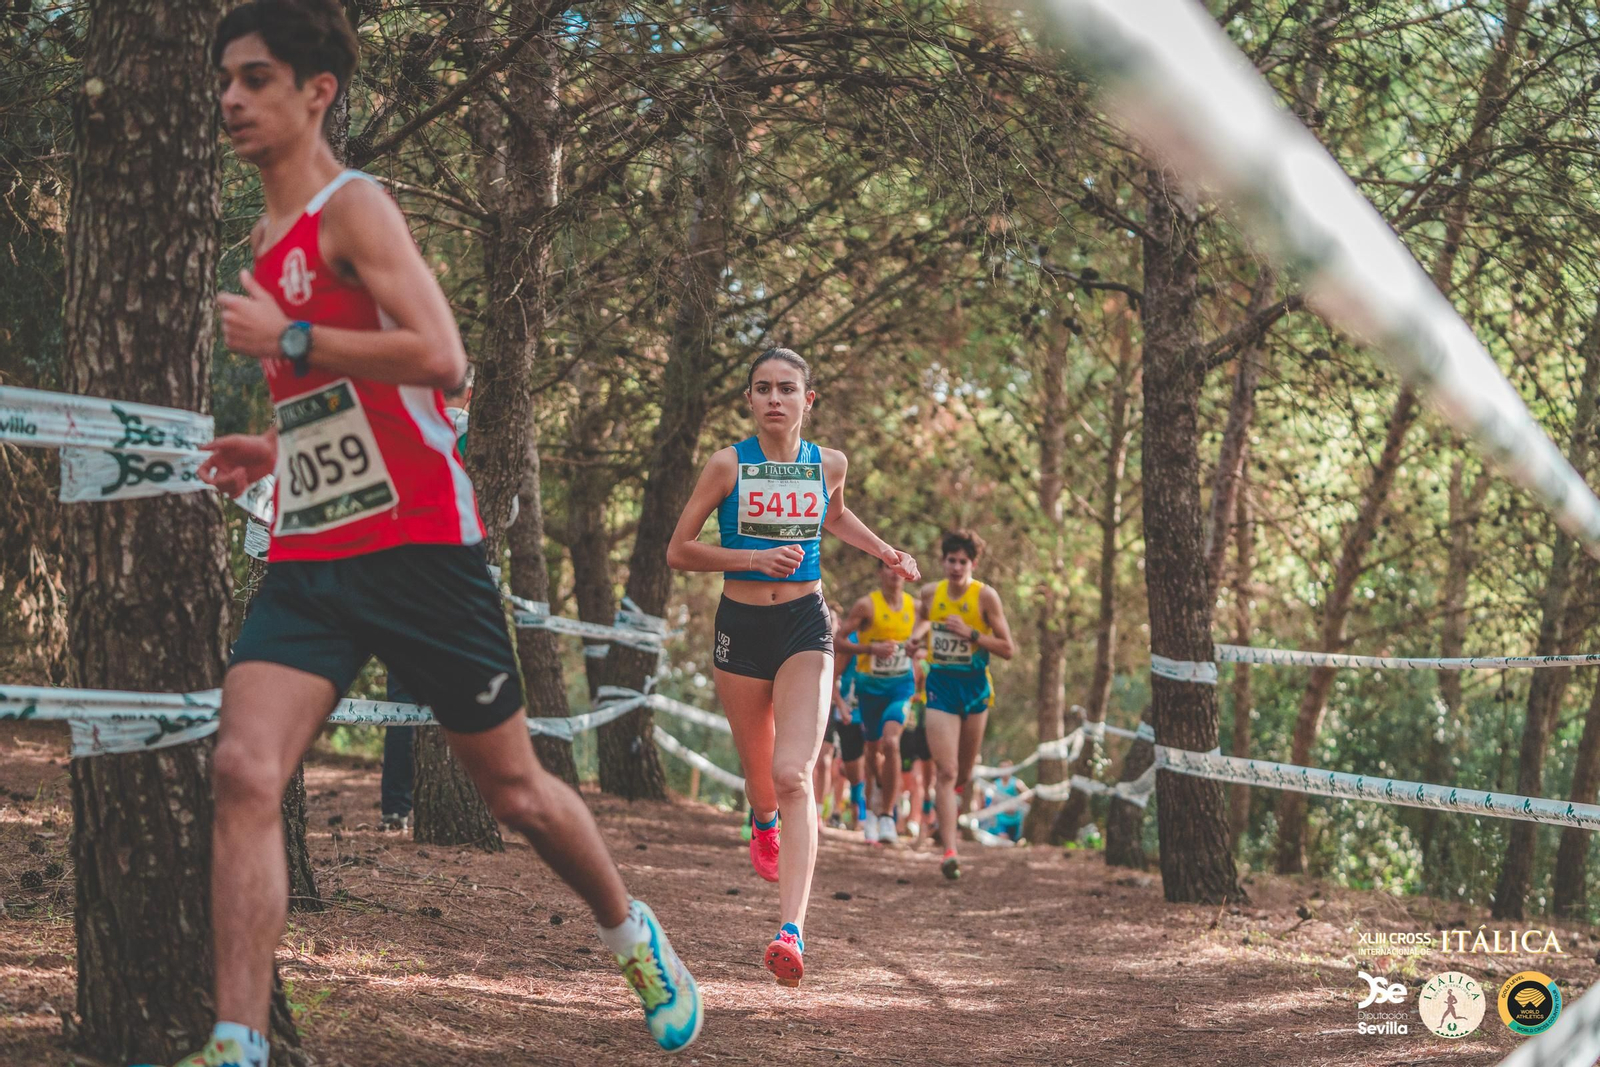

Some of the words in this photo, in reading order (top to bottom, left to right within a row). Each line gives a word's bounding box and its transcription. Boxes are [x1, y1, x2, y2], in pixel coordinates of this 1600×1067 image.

[764, 465, 801, 475] ITÁLICA
[747, 491, 819, 518] 5412
[933, 637, 969, 654] 8075
[875, 655, 907, 668] 807
